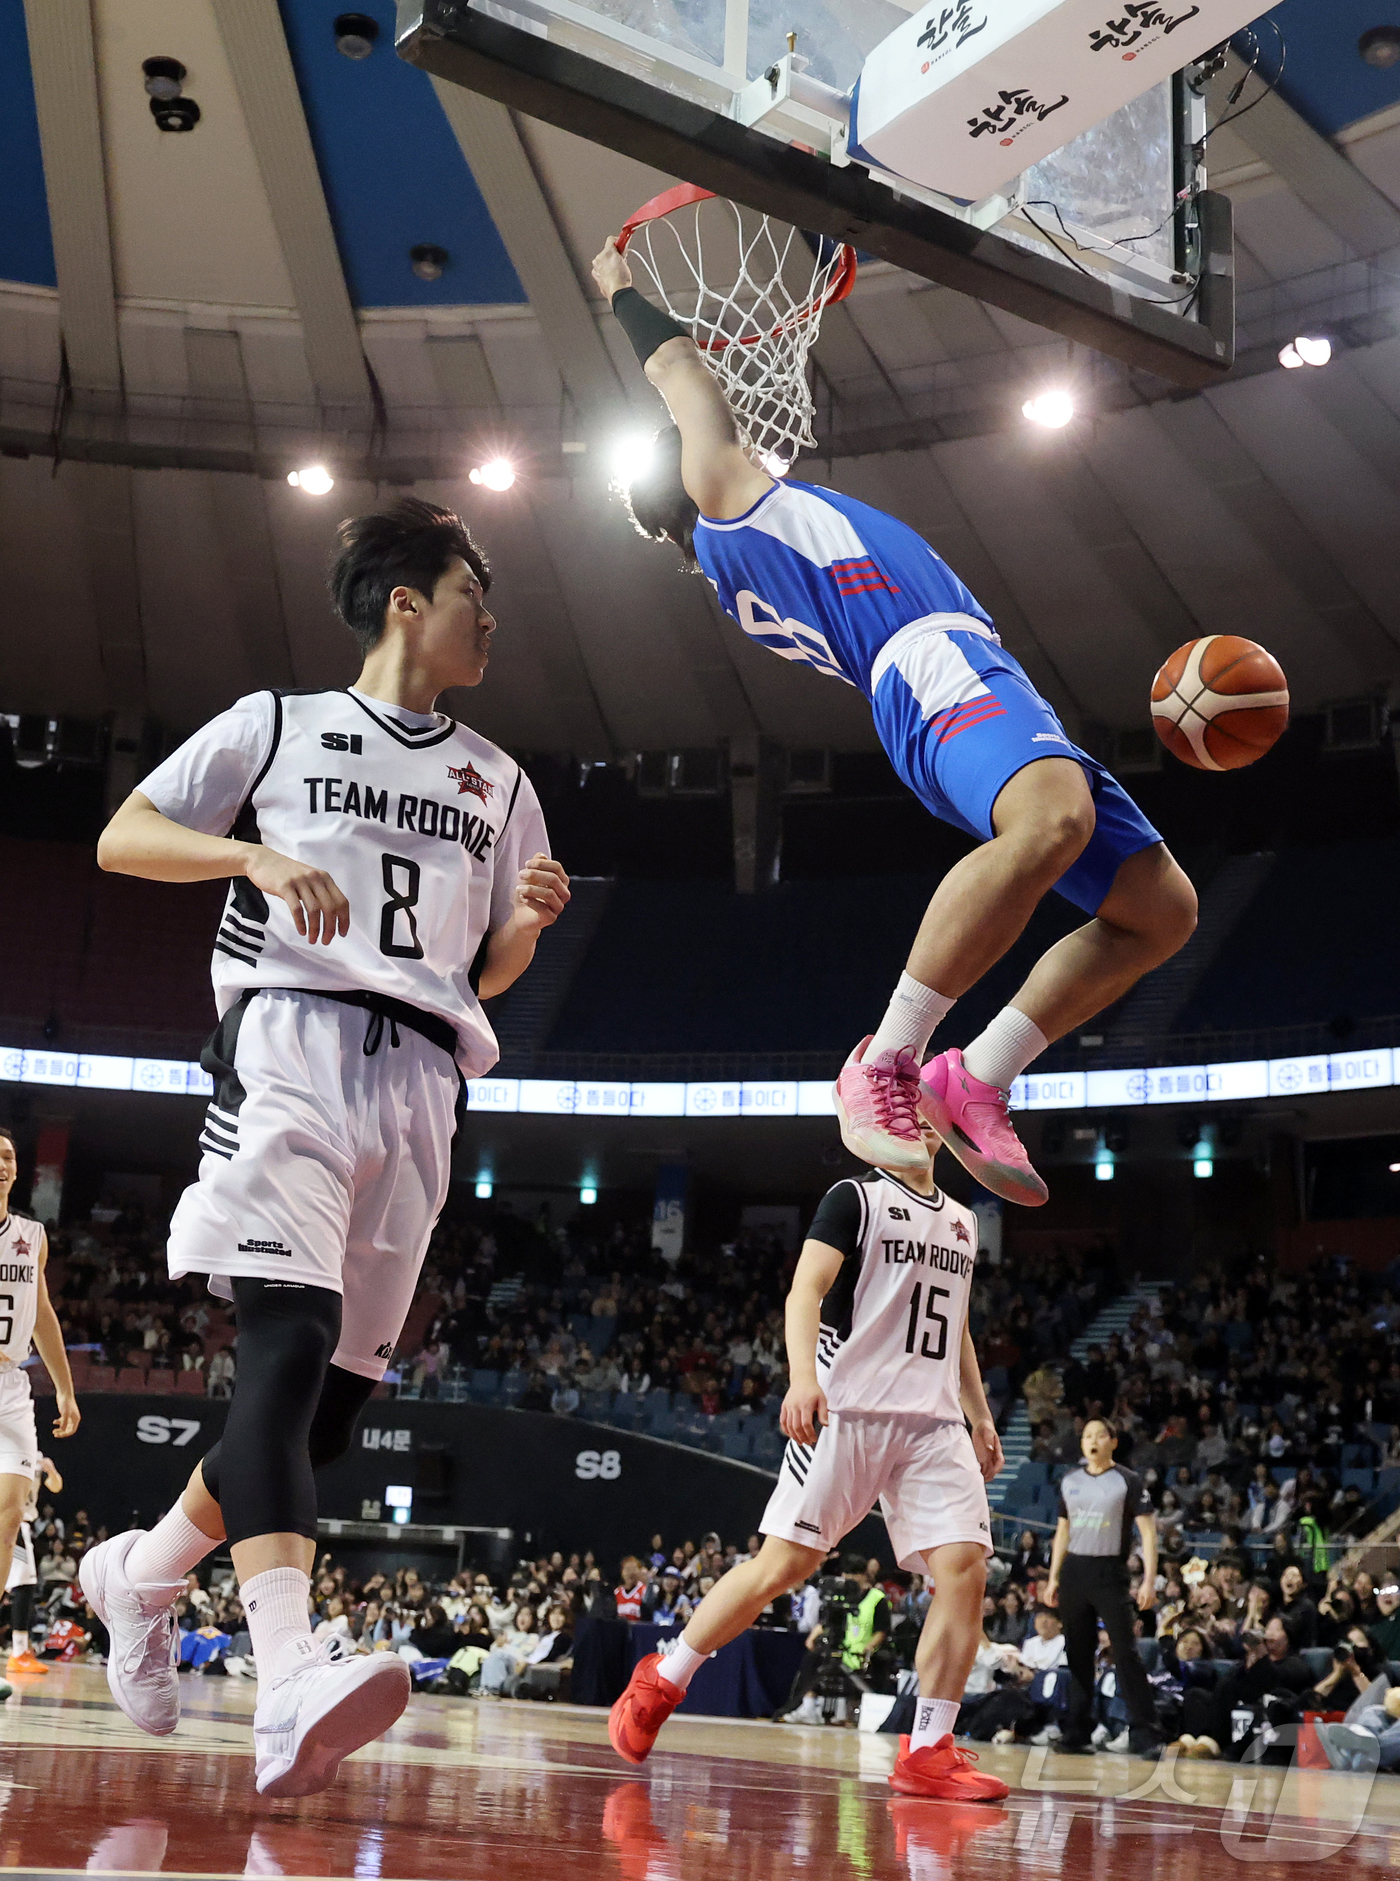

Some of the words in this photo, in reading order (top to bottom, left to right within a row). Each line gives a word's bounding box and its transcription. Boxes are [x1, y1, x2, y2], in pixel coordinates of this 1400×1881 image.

[917, 0, 987, 50] 한솔
[1089, 1, 1199, 51] 한솔
[967, 89, 1069, 138] 한솔
[321, 732, 362, 755] SI
[303, 777, 388, 823] TEAM
[397, 794, 495, 864] ROOKIE
[380, 853, 424, 960] 8
[888, 1206, 911, 1221] SI
[246, 1238, 284, 1249] Sports
[882, 1239, 926, 1265] TEAM
[905, 1281, 950, 1360] 15
[136, 1415, 200, 1446] S7
[361, 1427, 412, 1452] 내4문
[575, 1449, 621, 1480] S8
